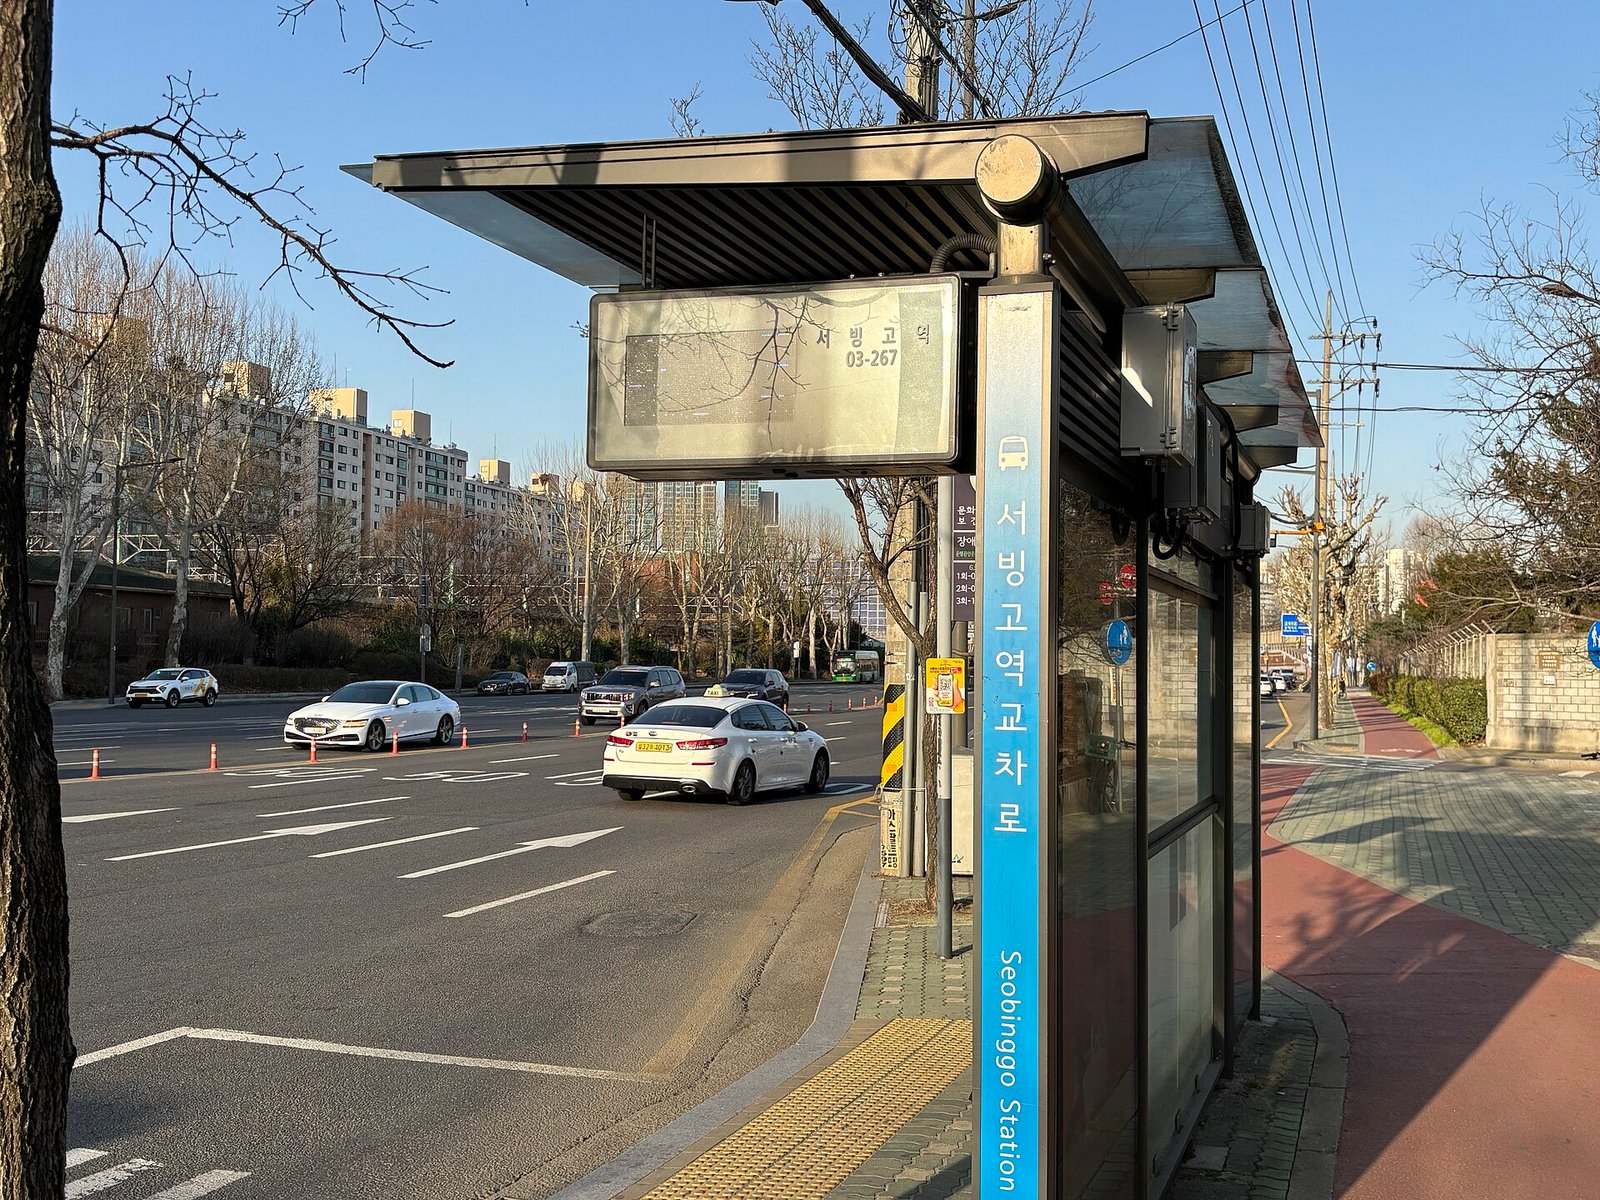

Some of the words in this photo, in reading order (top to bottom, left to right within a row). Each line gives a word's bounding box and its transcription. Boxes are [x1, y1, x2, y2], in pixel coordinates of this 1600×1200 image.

[846, 349, 898, 368] 03-267
[993, 500, 1028, 834] 서빙고역교차로
[995, 950, 1023, 1087] Seobinggo
[999, 1099, 1021, 1191] Station
